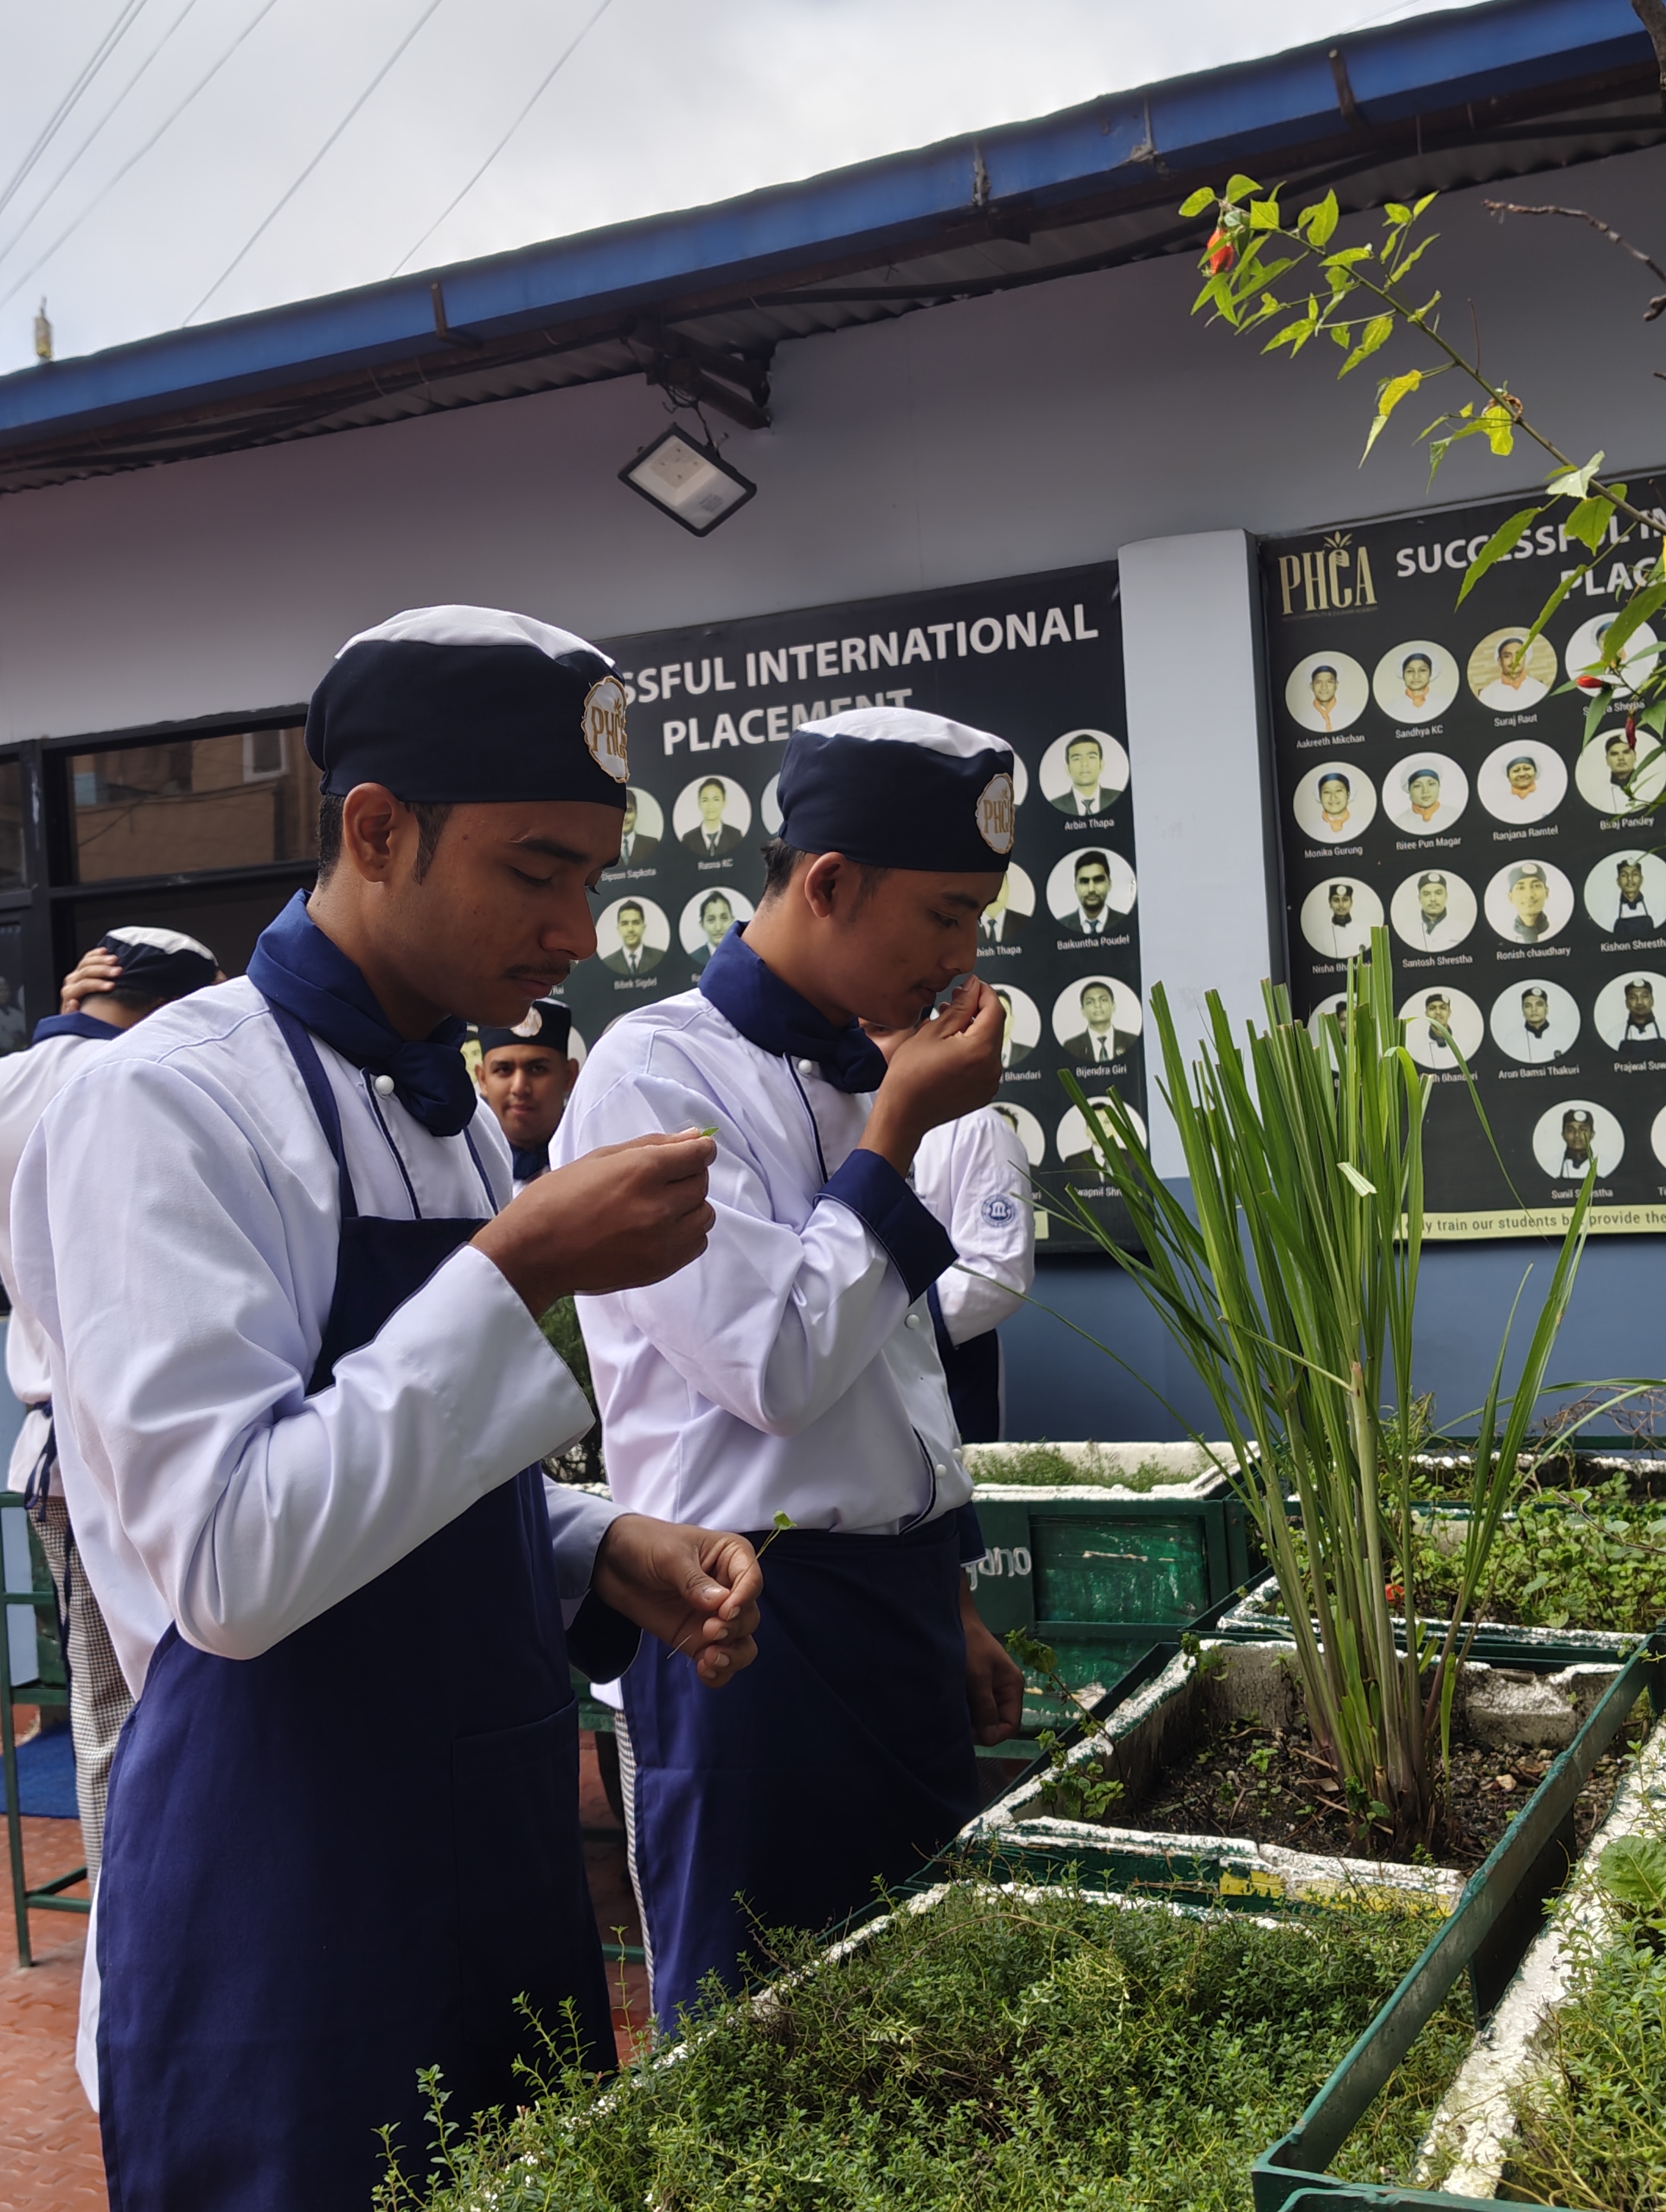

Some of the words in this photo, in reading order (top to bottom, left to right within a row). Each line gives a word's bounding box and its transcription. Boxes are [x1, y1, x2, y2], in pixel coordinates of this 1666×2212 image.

[1278, 546, 1377, 615] PHCA
[746, 603, 1099, 687] INTERNATIONAL
[1494, 717, 1516, 727] Suraj
[1431, 724, 1443, 735] KC
[1089, 818, 1115, 829] Thapa
[1436, 837, 1461, 848] Magar
[1304, 848, 1333, 858] Monika
[1334, 845, 1363, 856] Gurung
[1100, 934, 1130, 947] Poudel
[996, 944, 1022, 957] Thapa
[1402, 957, 1434, 968] Santosh
[1437, 954, 1473, 966] Shrestha
[1076, 1066, 1110, 1078] Bijendra
[1438, 1218, 1468, 1232] train
[1472, 1219, 1494, 1231] our
[1498, 1214, 1557, 1229] students
[1590, 1211, 1640, 1227] provide
